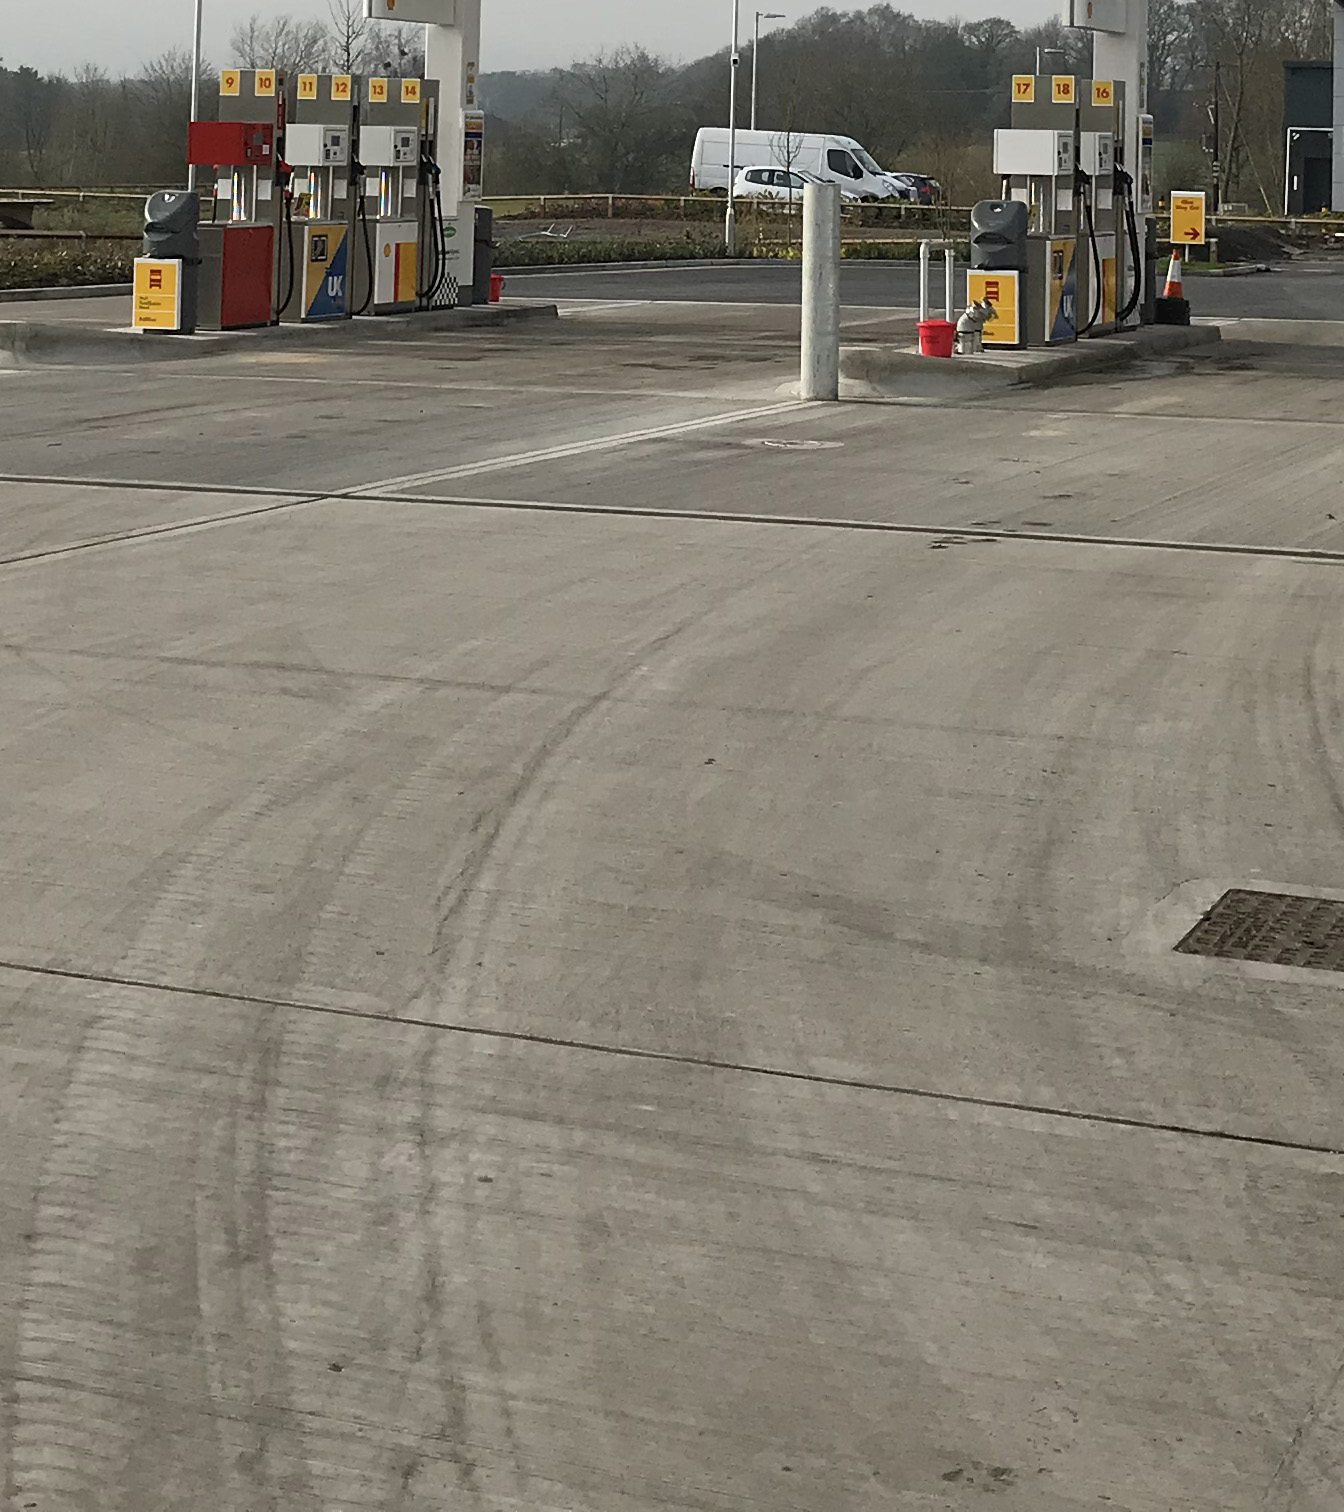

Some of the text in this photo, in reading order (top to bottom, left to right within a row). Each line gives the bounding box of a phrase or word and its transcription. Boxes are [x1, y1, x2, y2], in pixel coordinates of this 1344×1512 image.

[225, 76, 235, 88] 9
[258, 77, 272, 89] 10
[302, 81, 313, 92] 11
[334, 82, 348, 93] 12
[372, 85, 384, 95] 13
[404, 85, 417, 96] 14
[1015, 82, 1031, 95] 17
[1055, 83, 1070, 95] 18
[1095, 87, 1110, 99] 16
